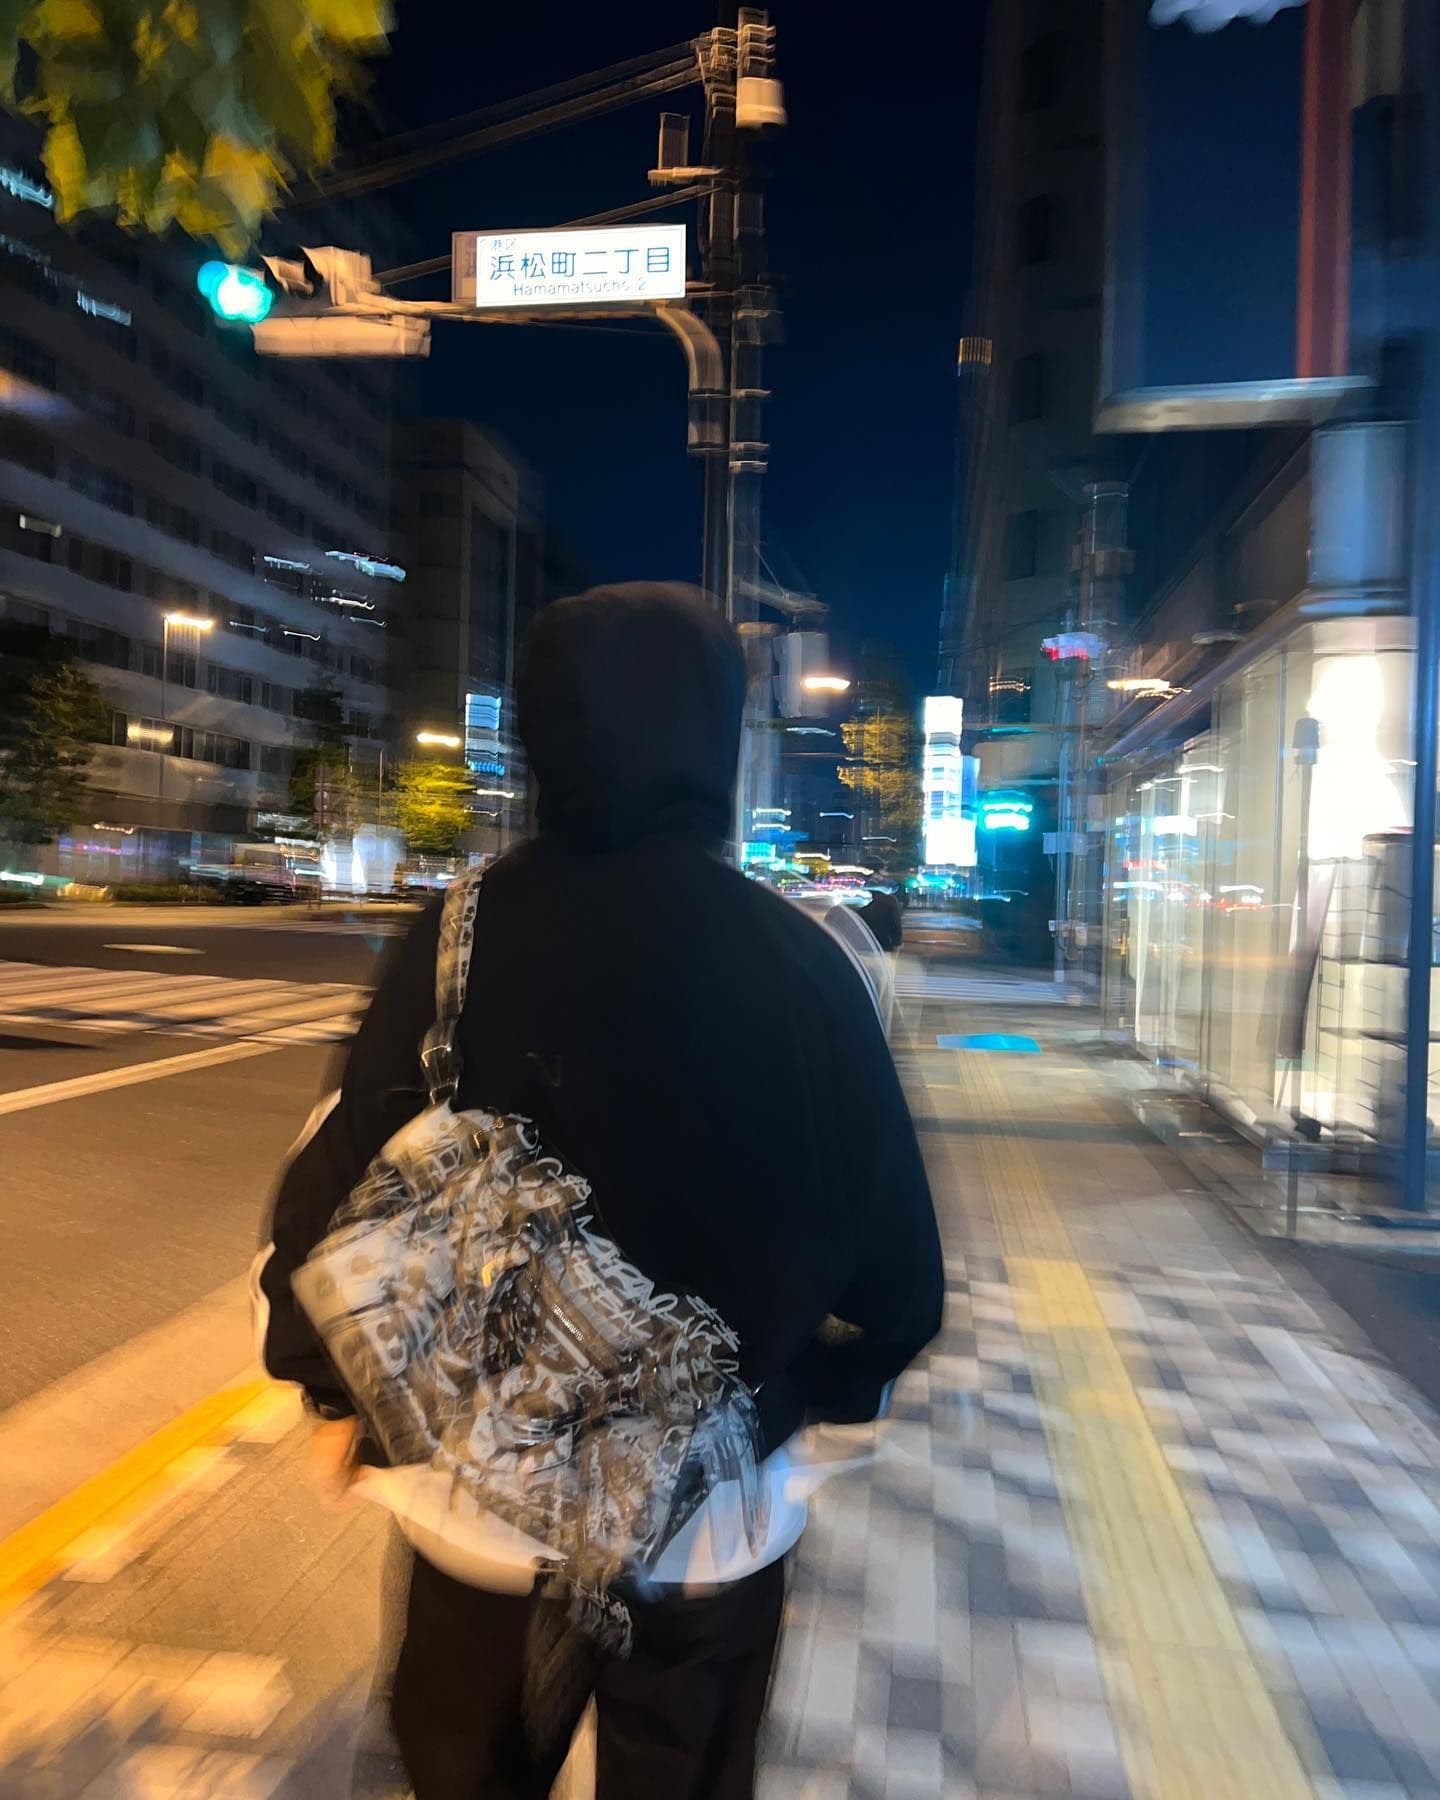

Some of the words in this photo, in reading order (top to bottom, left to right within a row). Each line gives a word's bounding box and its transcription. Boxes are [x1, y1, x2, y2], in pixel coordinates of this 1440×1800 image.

[490, 247, 670, 281] 浜松町二丁目
[638, 278, 647, 291] 2
